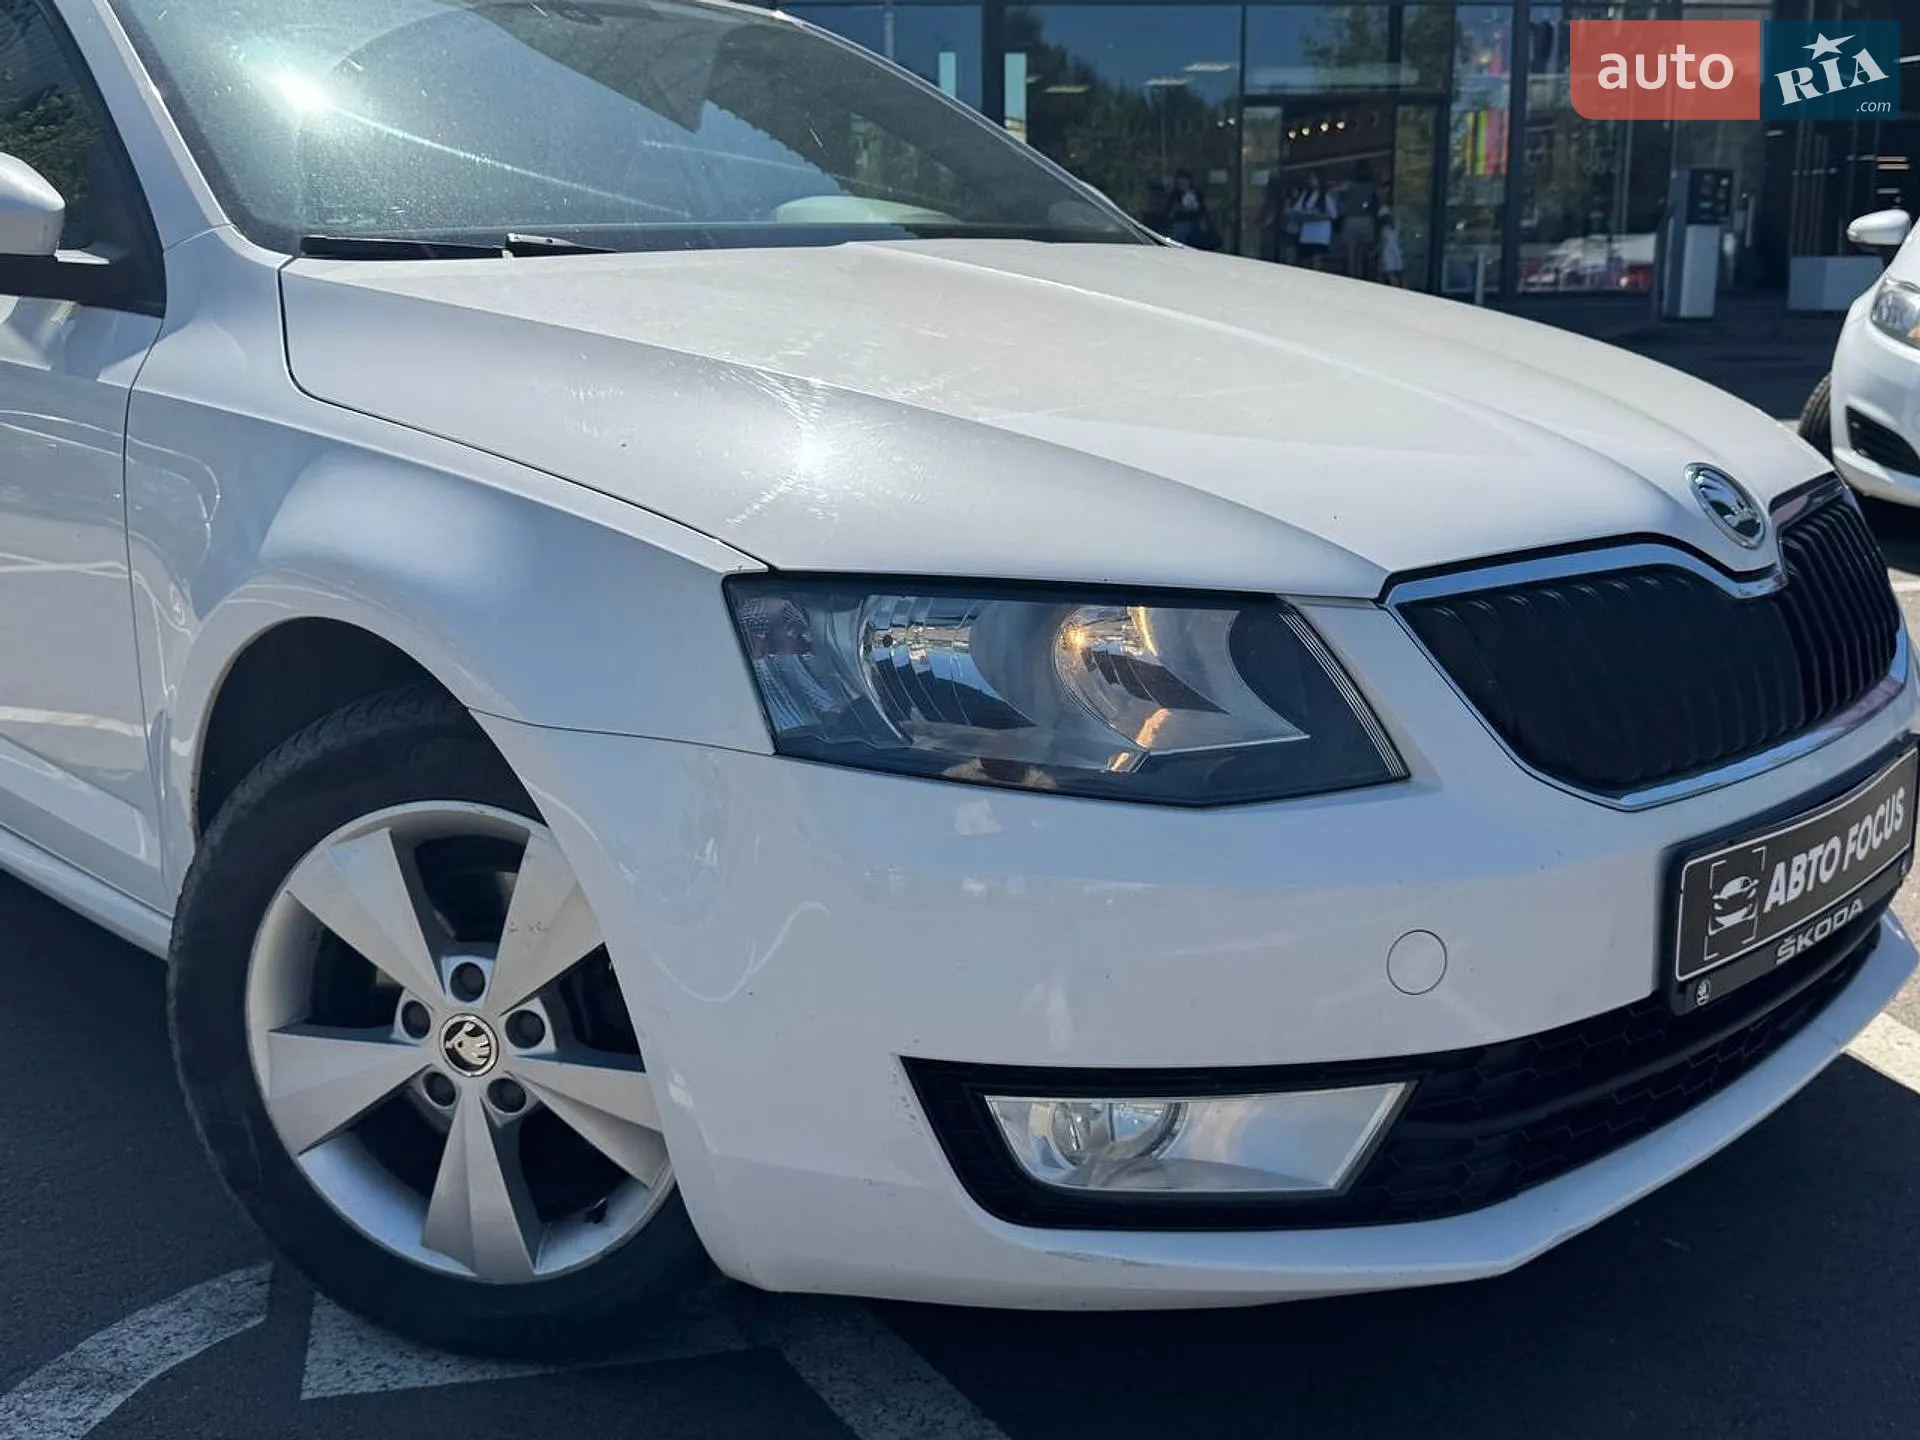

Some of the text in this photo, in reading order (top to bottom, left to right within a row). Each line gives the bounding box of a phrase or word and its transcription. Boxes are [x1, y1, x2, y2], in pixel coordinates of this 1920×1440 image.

[1762, 786, 1905, 913] АВТО FOCUS
[1776, 896, 1865, 965] ŠKODA
